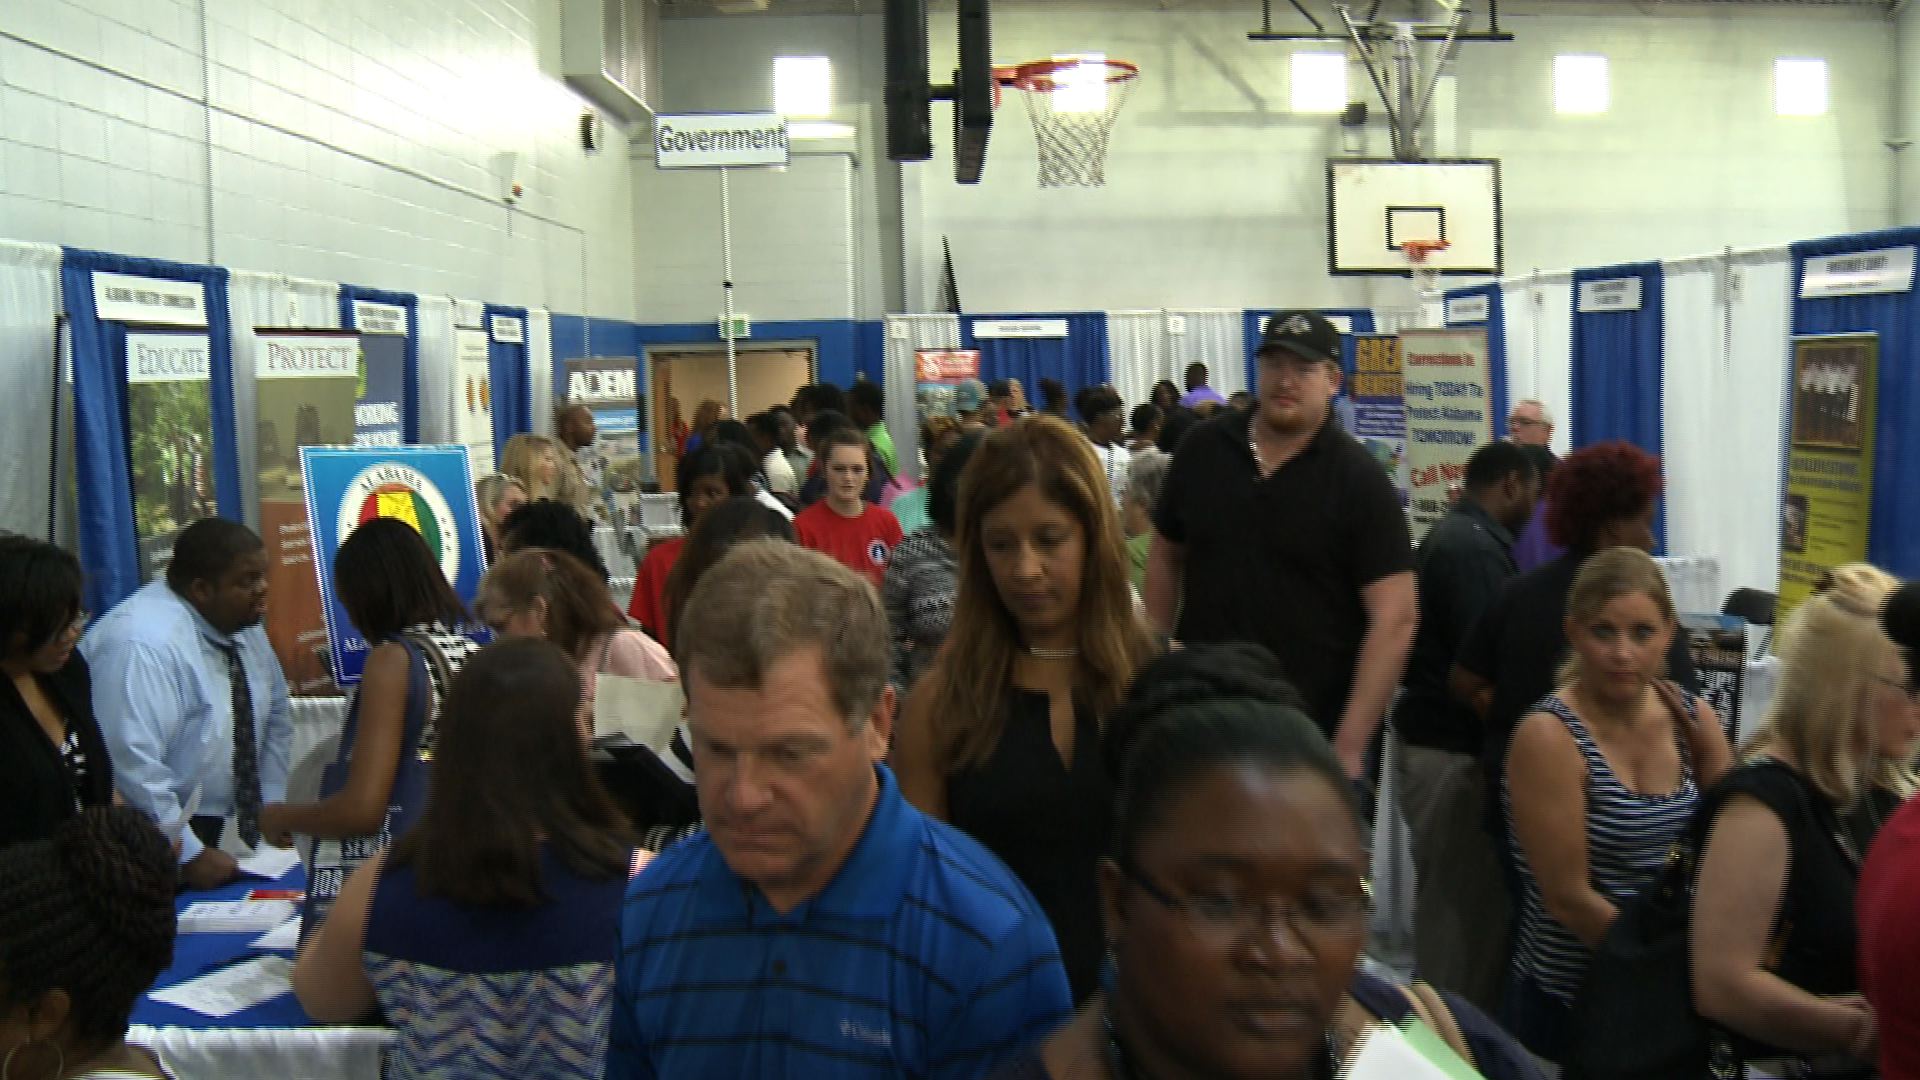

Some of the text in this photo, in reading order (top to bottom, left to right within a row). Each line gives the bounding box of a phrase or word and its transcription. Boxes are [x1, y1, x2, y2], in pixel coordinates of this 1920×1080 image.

[659, 123, 785, 151] Government
[1863, 256, 1888, 270] COUNTY
[105, 287, 196, 311] ALABAMA FORESTRY COMMISSION
[136, 343, 205, 375] EDUCATE
[267, 341, 351, 370] PROTECT
[1358, 339, 1402, 372] GREA
[1407, 351, 1463, 369] Corrections
[567, 369, 637, 402] ADEM
[1354, 374, 1403, 397] BENEFI
[1434, 381, 1468, 398] TODAY
[1468, 383, 1484, 398] To
[1404, 405, 1439, 420] Protect
[1440, 406, 1483, 423] Alabama
[1411, 430, 1476, 445] TOMORROW!
[359, 466, 423, 493] ALABAMA
[1410, 465, 1438, 488] Call
[343, 638, 372, 652] ALA
[1705, 670, 1736, 691] UP!
[310, 869, 343, 898] JOB
